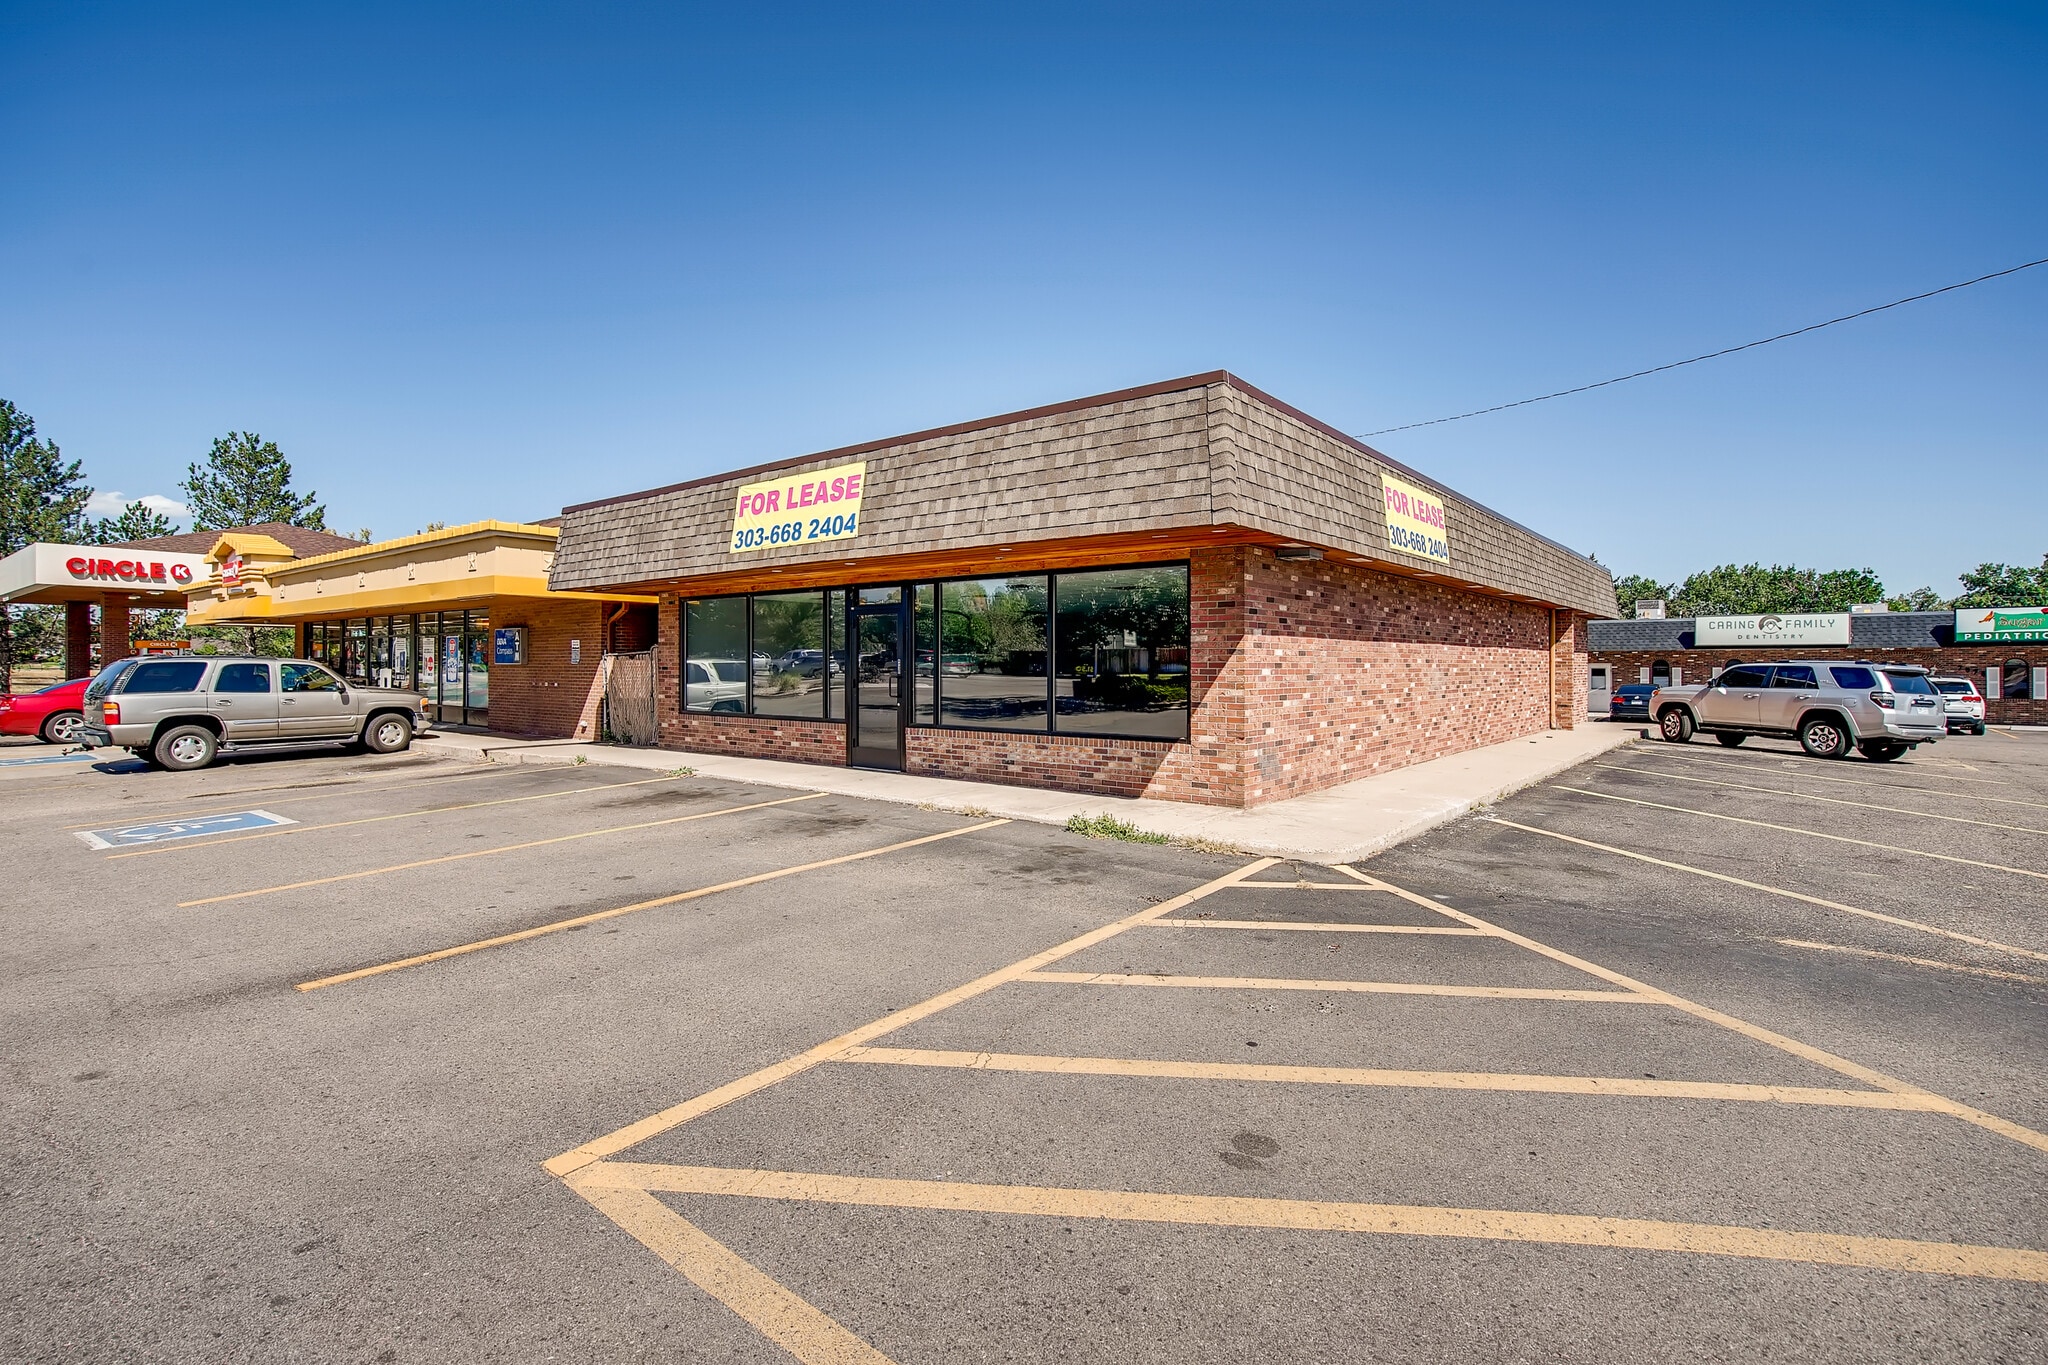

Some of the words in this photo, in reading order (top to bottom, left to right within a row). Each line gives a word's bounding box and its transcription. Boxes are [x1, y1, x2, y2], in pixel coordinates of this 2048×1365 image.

[738, 489, 780, 517] FOR
[786, 474, 862, 510] LEASE
[1385, 486, 1410, 517] FOR
[1411, 496, 1445, 529] LEASE
[734, 521, 803, 549] 303-668
[807, 513, 857, 539] 2404
[1389, 524, 1427, 554] 303-668
[1428, 537, 1449, 560] 2404
[66, 557, 165, 579] CIRCLE
[173, 565, 190, 579] K
[1708, 620, 1755, 630] CARING
[1785, 618, 1836, 629] FAMILY
